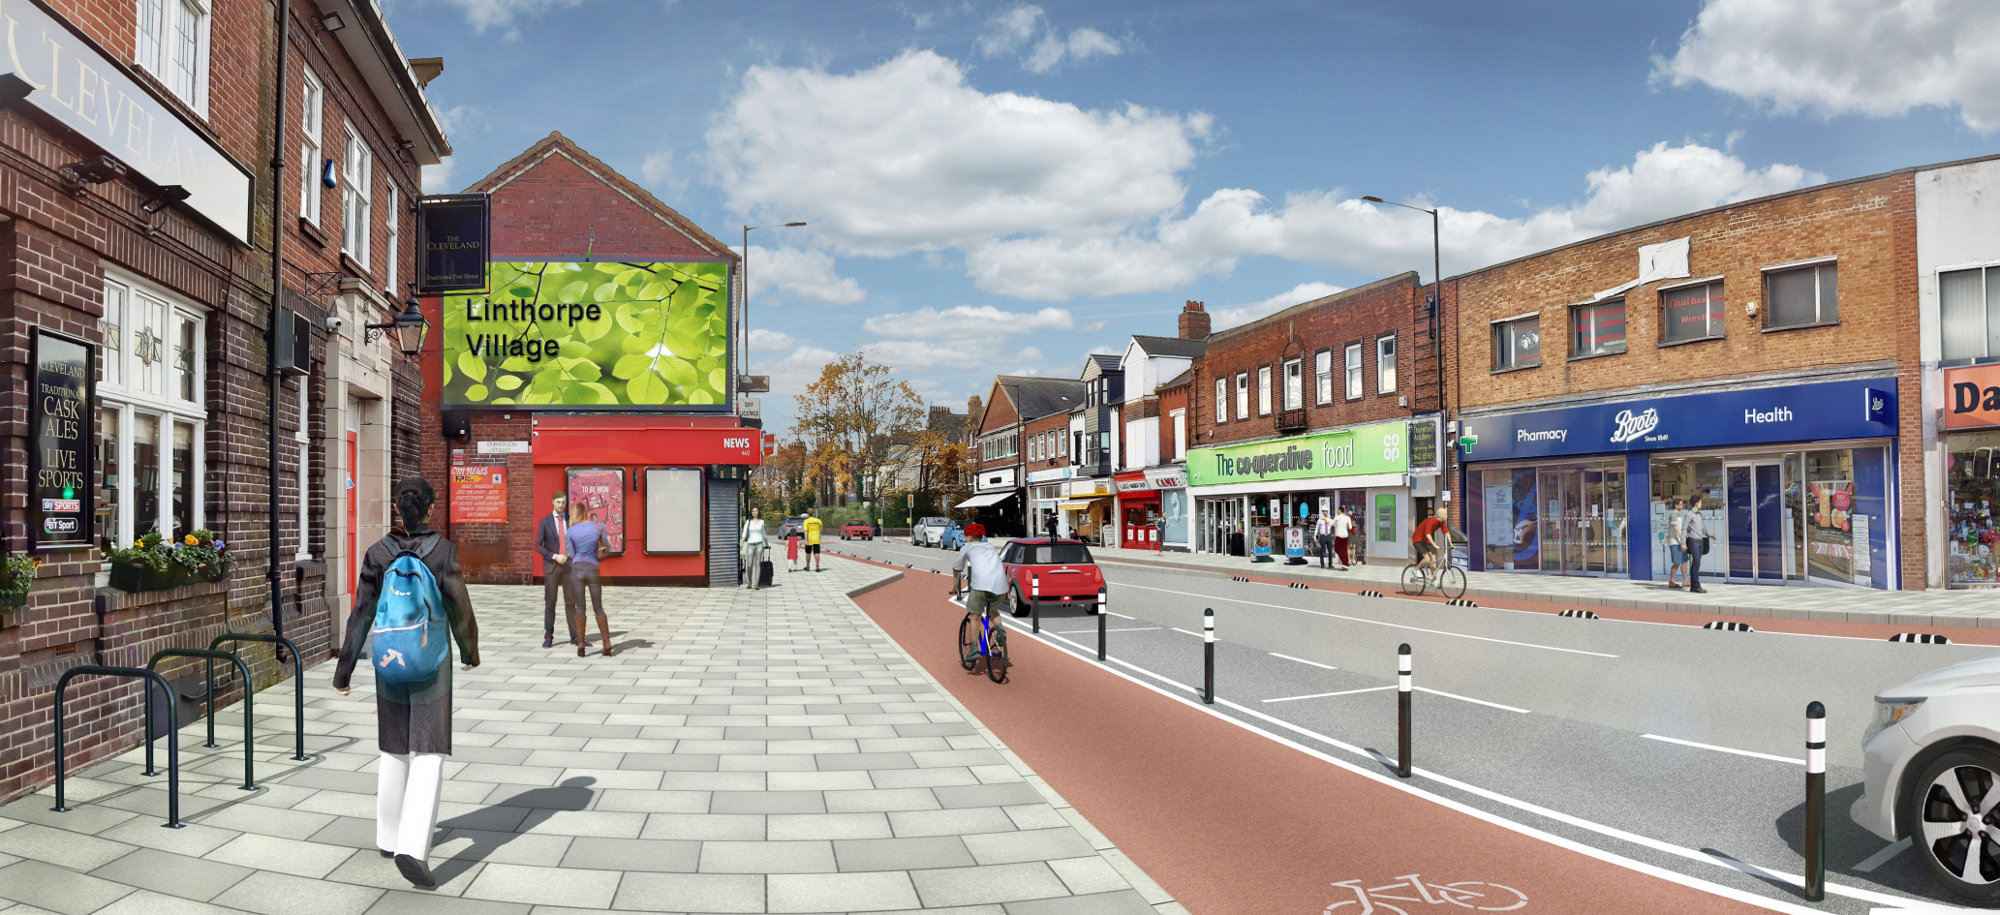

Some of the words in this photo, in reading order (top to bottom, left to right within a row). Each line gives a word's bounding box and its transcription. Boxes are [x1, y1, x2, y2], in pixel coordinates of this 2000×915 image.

[4, 14, 212, 184] CLEVELAN
[427, 241, 480, 250] CLEVELAND
[466, 298, 601, 327] Linthorpe
[1668, 299, 1690, 309] Thai
[466, 333, 560, 362] Village
[39, 361, 85, 379] CLEVELAND
[41, 383, 84, 400] TRADITIONA
[1953, 382, 2000, 414] Da
[44, 396, 80, 420] CASK
[1744, 406, 1793, 424] Health
[45, 418, 79, 440] ALES
[1610, 407, 1659, 443] Boots
[723, 438, 750, 448] NEWS
[1517, 428, 1567, 442] Pharmacy
[47, 448, 76, 469] LIVE
[1215, 453, 1234, 476] The
[1236, 445, 1313, 478] co-operative
[1322, 438, 1354, 469] food
[38, 469, 84, 489] SPORTS
[451, 467, 465, 475] CM
[465, 467, 488, 475] NEWS
[44, 502, 53, 510] sky
[54, 501, 78, 510] SPORTS
[58, 520, 75, 531] Sport
